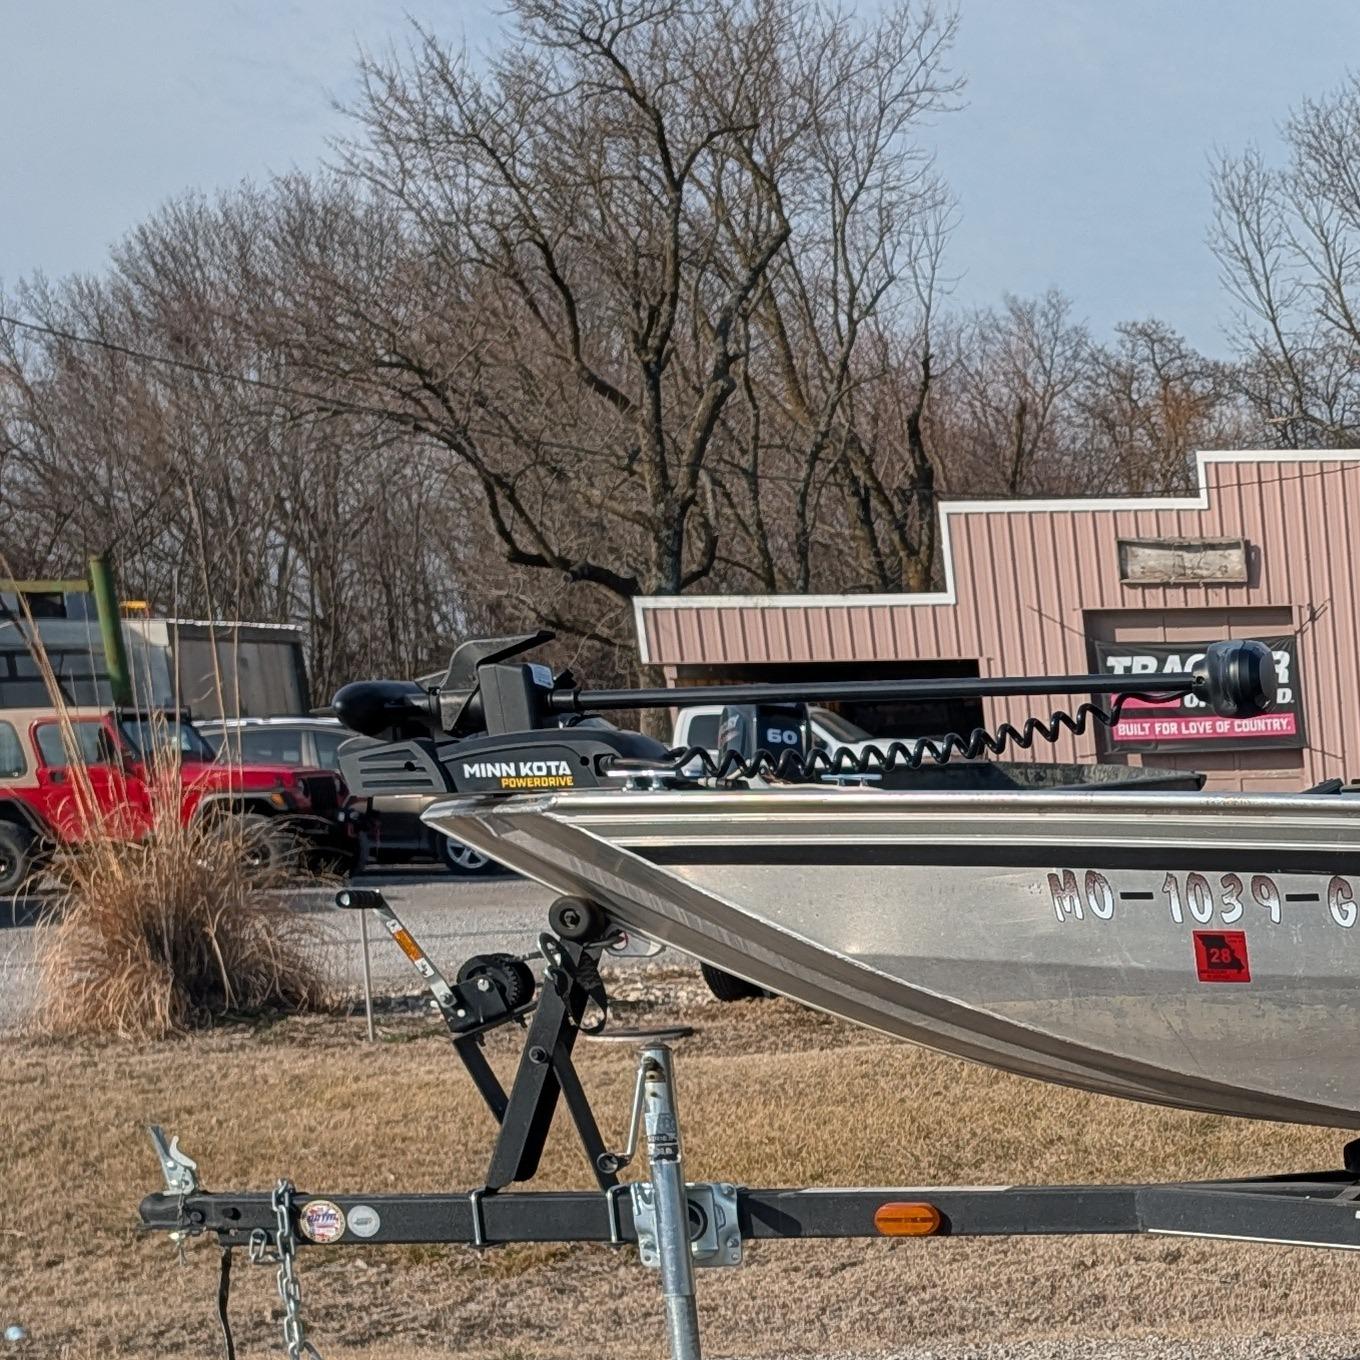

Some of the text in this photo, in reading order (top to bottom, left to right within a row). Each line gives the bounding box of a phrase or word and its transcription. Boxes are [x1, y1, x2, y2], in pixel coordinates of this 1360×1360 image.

[1118, 723, 1151, 736] BUILT
[1155, 722, 1179, 735] FOR
[1181, 720, 1212, 735] LOVE
[1215, 719, 1231, 732] OF
[766, 728, 798, 745] 60
[463, 761, 572, 779] MINN KOTA
[501, 776, 574, 789] POWERDRIVE
[1209, 948, 1231, 963] 28
